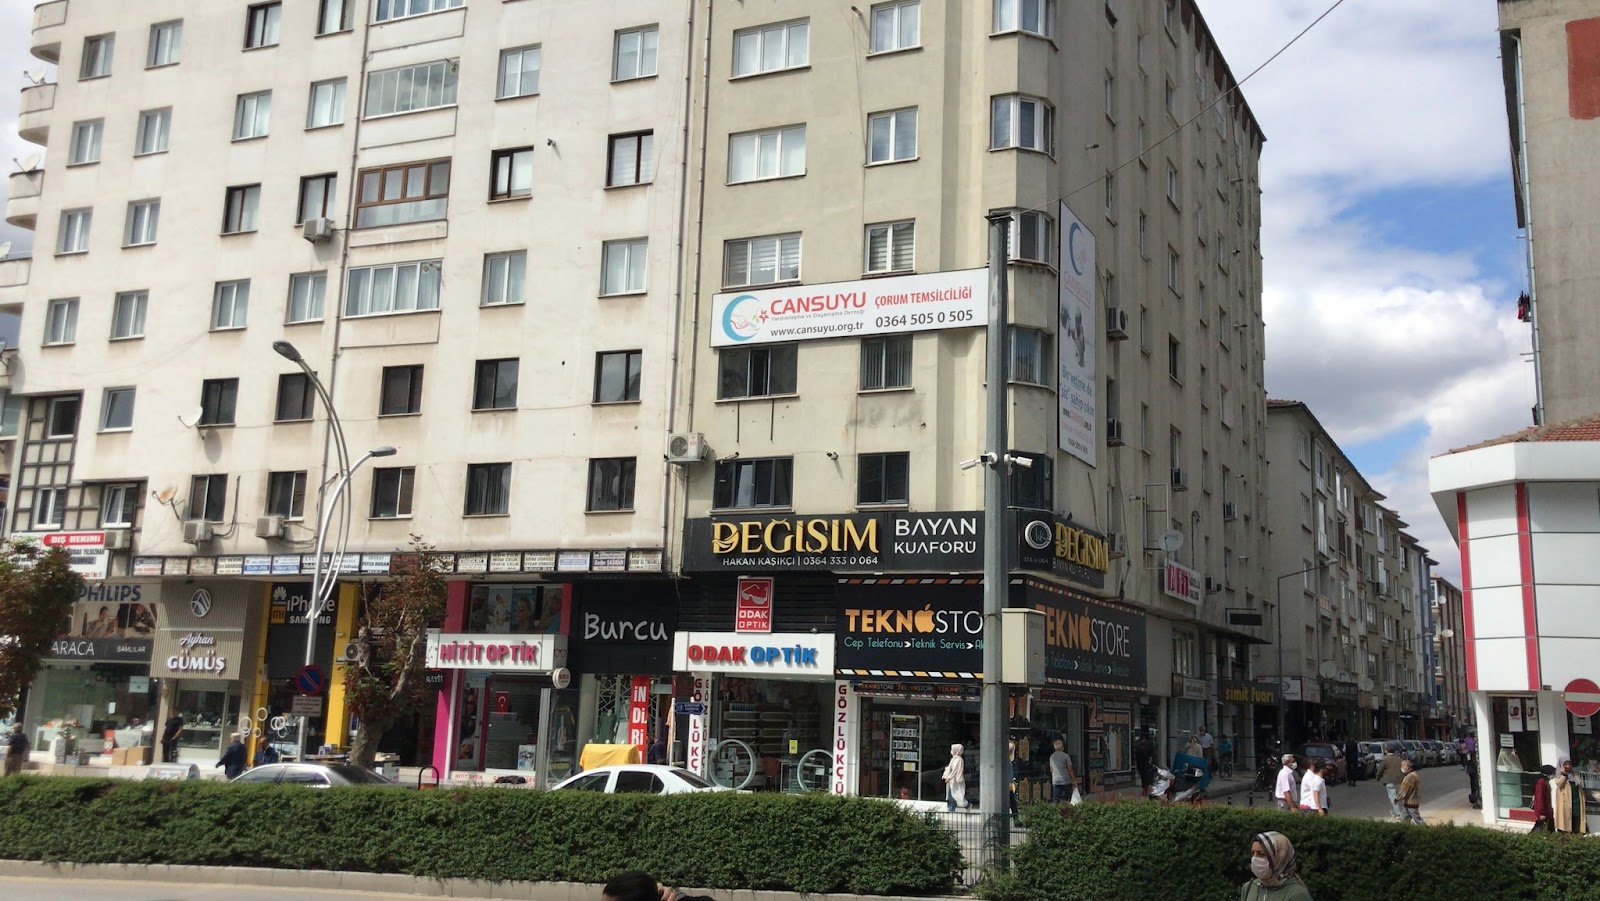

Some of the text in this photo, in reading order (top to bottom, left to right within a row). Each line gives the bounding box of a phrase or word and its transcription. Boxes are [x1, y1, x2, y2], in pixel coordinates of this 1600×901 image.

[770, 292, 867, 315] CANSUYU
[875, 286, 972, 309] ÇORUM TEMSİLCİLİĞİ
[875, 310, 973, 327] 0364 505 0 505
[771, 321, 864, 336] www.cansuyu.org.tr
[895, 518, 976, 536] BAYAN
[894, 541, 976, 554] KUAFÖRÜ
[723, 558, 755, 566] HAKAN
[758, 557, 795, 567] KAŞIKÇI
[803, 557, 827, 565] 0364
[830, 557, 847, 565] 333
[859, 556, 878, 564] 064
[290, 616, 331, 624] SAMNG
[584, 612, 668, 641] Burcu
[179, 632, 215, 648] Ayhan
[844, 637, 864, 650] Cep
[867, 637, 904, 648] Telefonu
[911, 638, 936, 649] Teknik
[940, 639, 965, 649] Servis
[440, 641, 538, 663] HİTİT OPTİK
[688, 644, 818, 666] ODAK OPTİK
[167, 651, 226, 674] GÜMÜŞ
[836, 685, 847, 794] GÖZLÜKÇÜ
